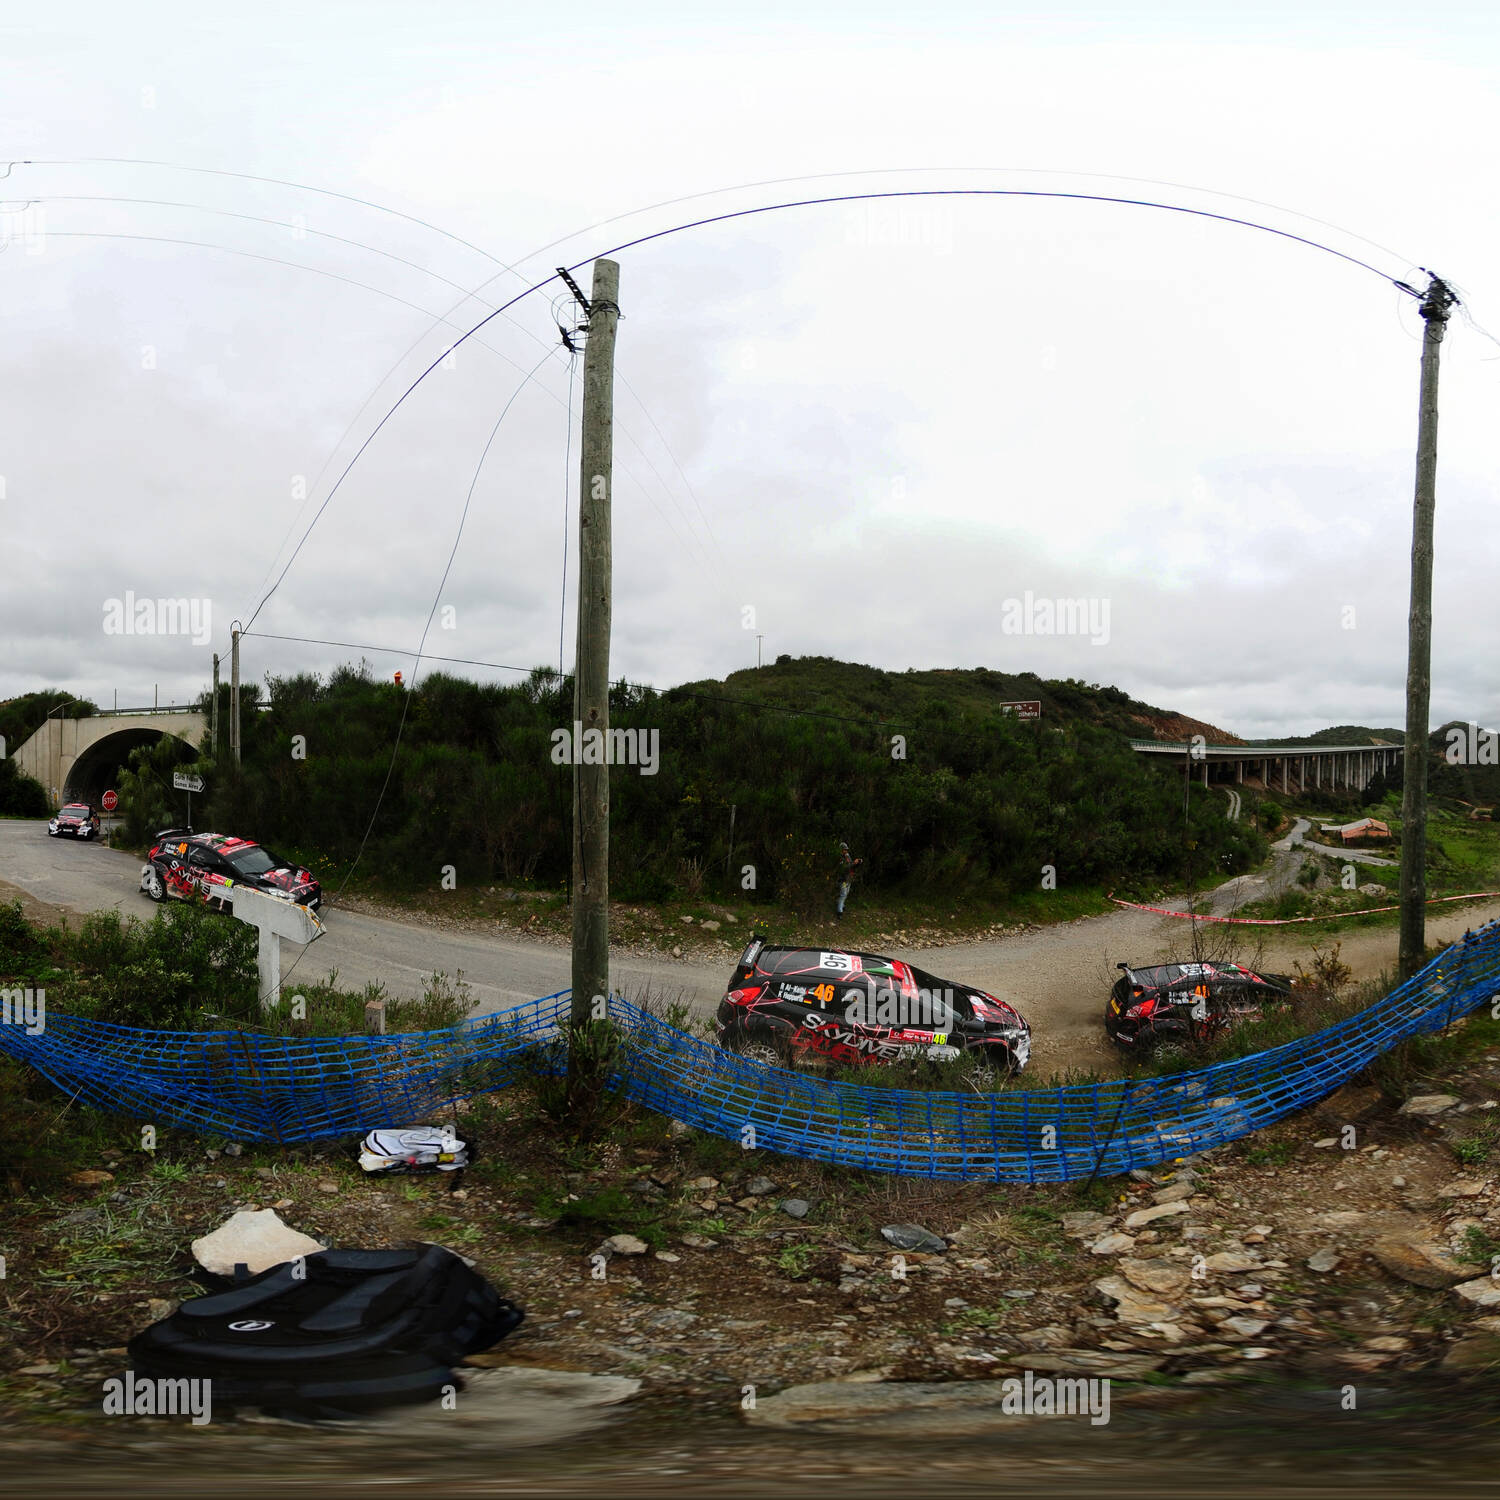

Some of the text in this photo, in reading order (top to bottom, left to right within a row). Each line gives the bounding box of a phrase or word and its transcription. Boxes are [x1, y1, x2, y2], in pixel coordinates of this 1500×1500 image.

[103, 797, 117, 805] STOP
[813, 983, 836, 1002] 46
[934, 1034, 946, 1045] 46
